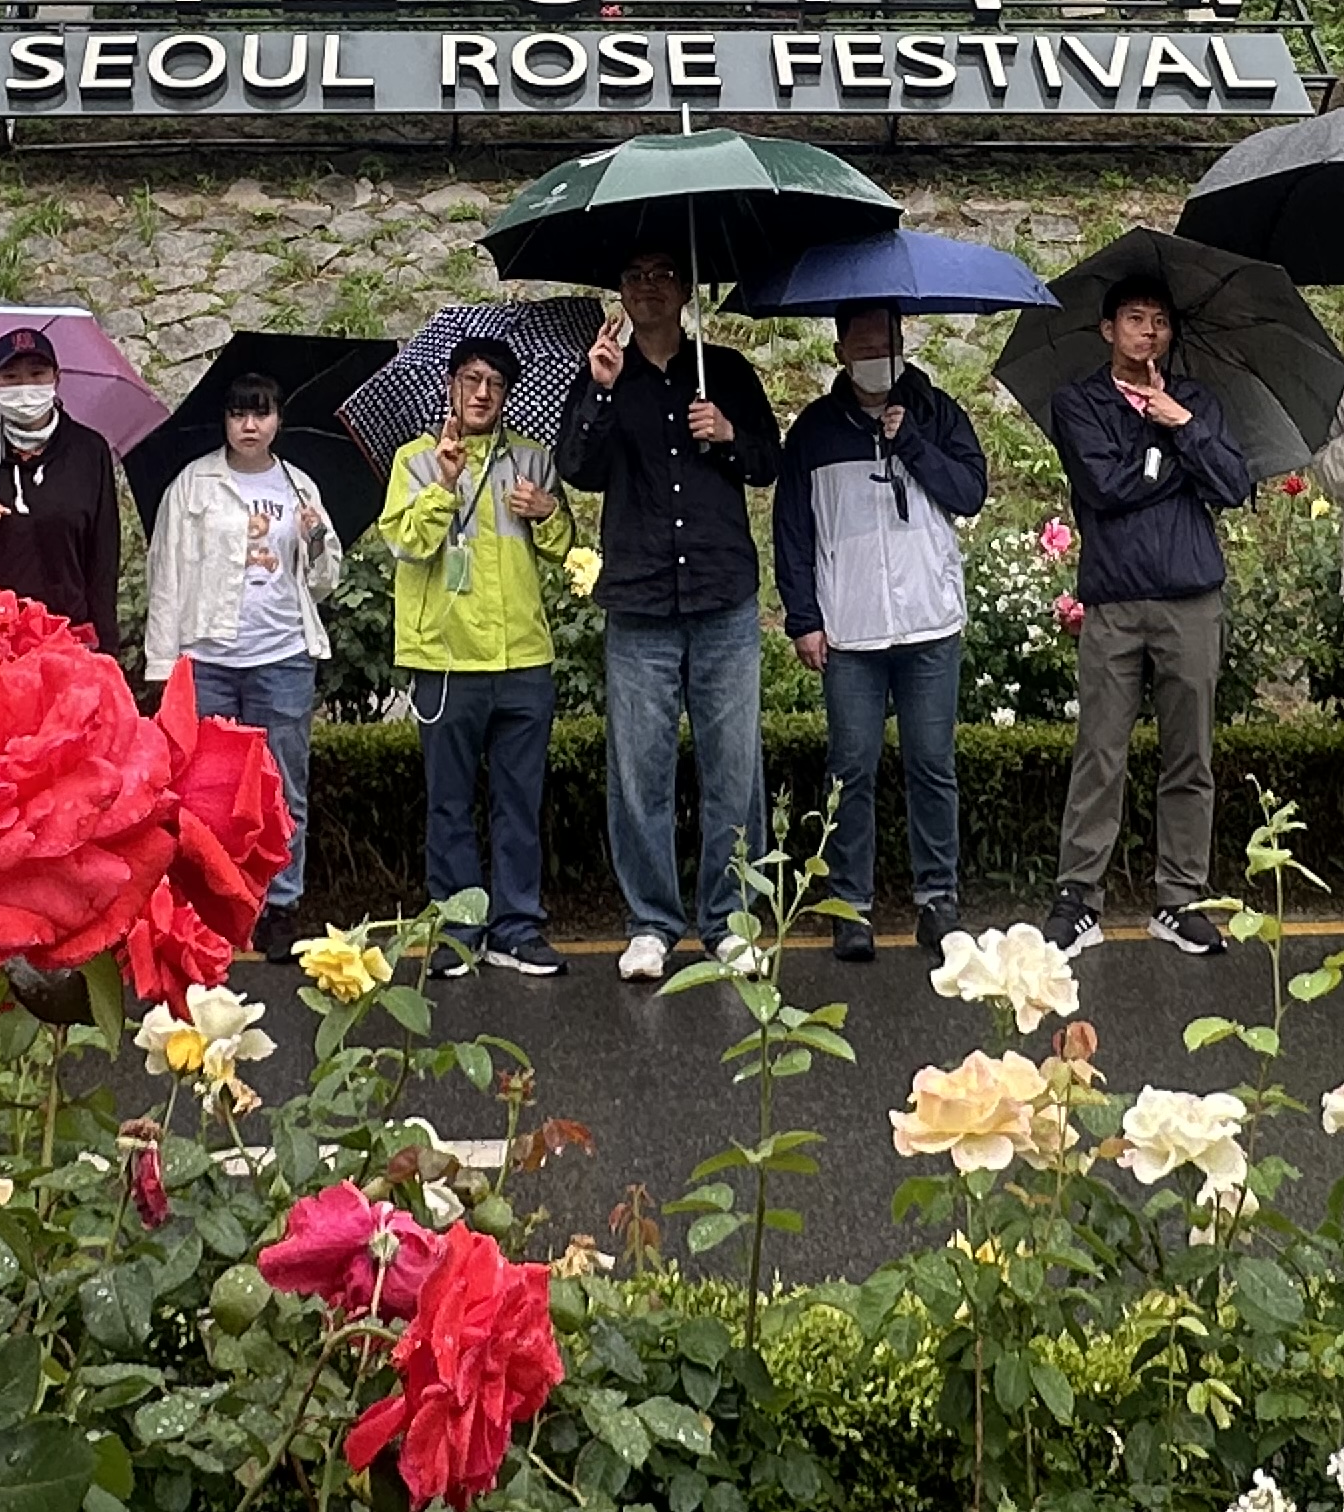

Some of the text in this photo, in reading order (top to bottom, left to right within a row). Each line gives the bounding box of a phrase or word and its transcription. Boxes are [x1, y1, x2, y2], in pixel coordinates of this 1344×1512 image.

[5, 33, 1278, 90] SEOUL ROSE FESTIVAL
